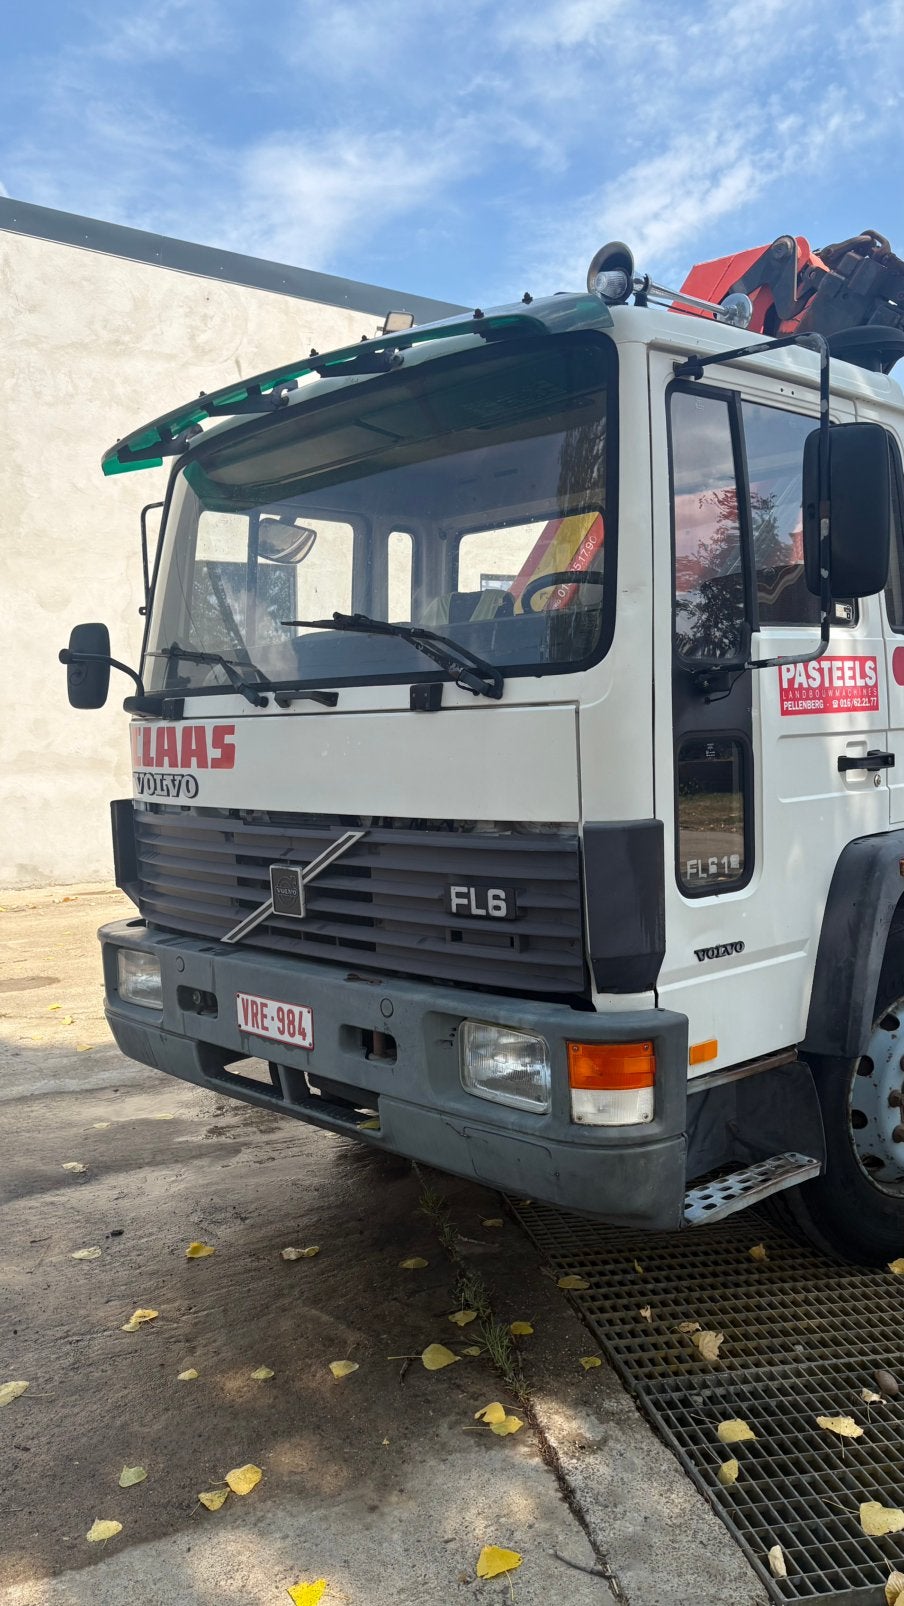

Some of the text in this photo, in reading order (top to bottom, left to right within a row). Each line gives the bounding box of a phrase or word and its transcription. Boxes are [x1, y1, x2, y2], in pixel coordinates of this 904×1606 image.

[781, 660, 876, 689] PASTEELS
[782, 687, 878, 700] LANDBOUWMACHINES
[783, 700, 824, 711] PELLENBERG
[131, 725, 236, 769] CLAAS
[133, 771, 199, 799] VOLVO
[450, 886, 507, 917] FL6
[693, 940, 745, 962] VOLVO
